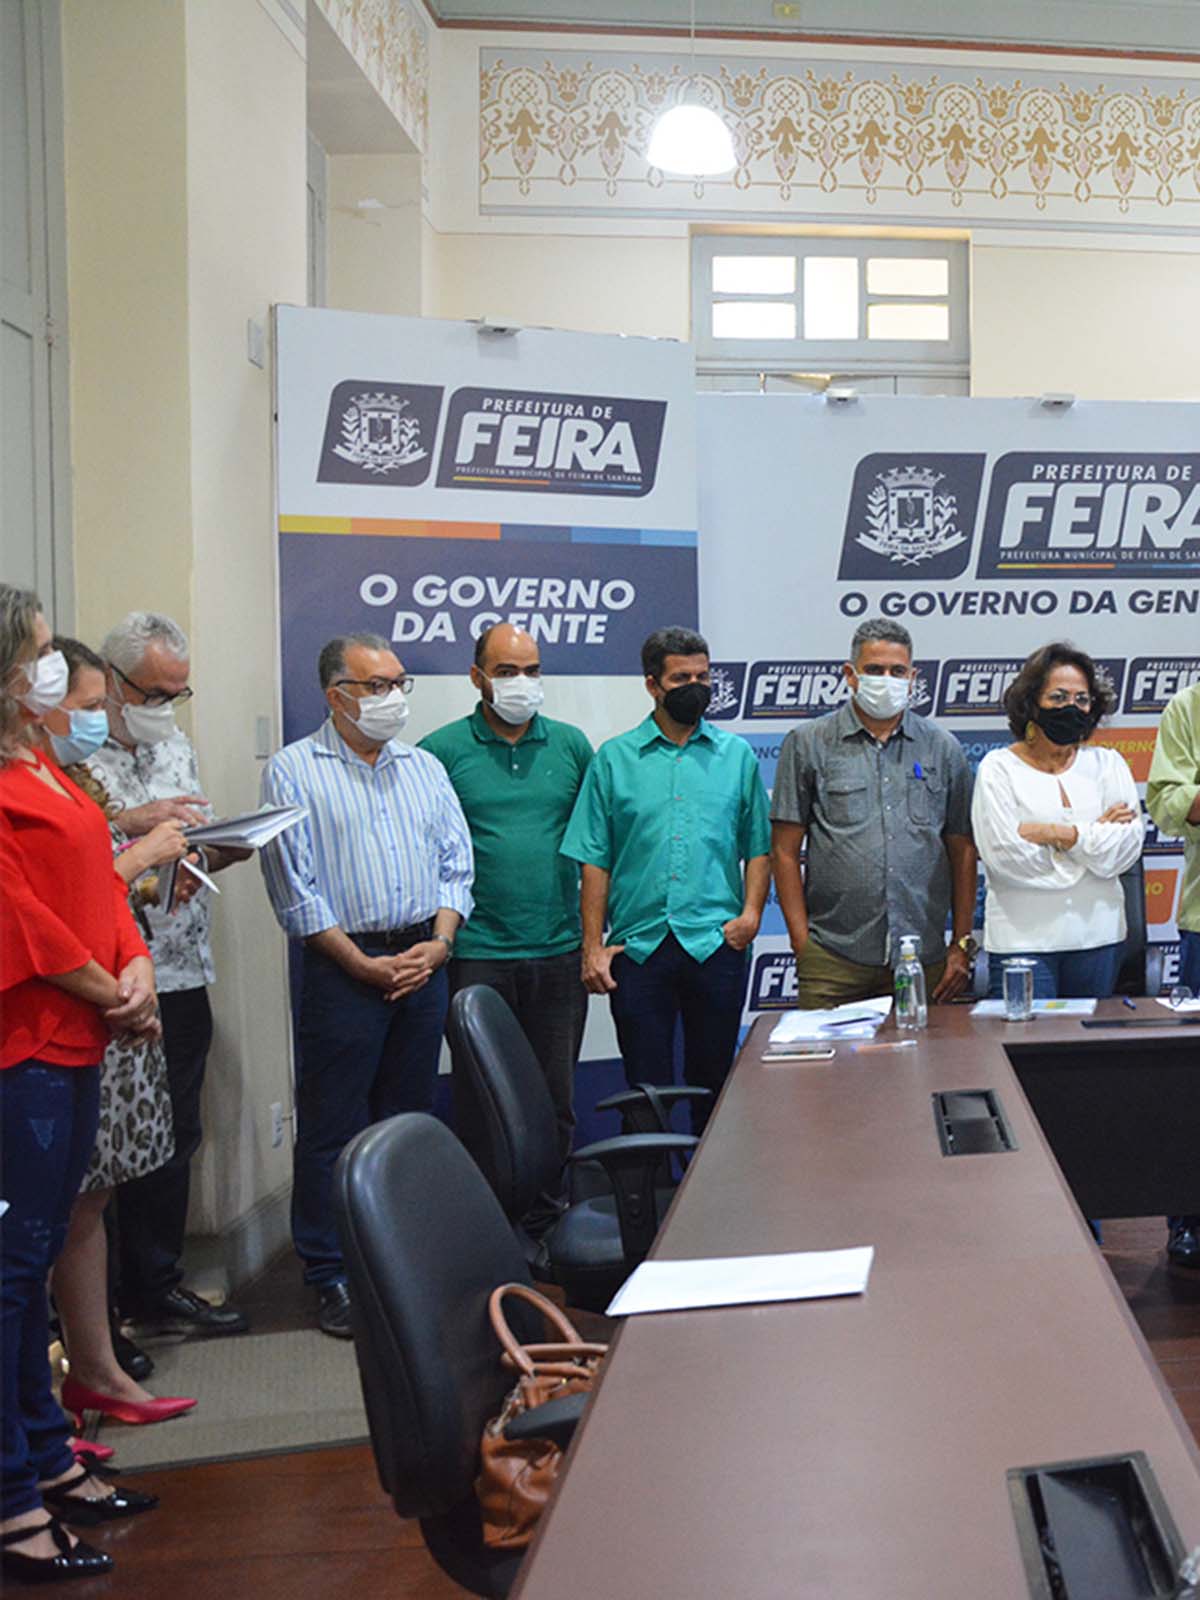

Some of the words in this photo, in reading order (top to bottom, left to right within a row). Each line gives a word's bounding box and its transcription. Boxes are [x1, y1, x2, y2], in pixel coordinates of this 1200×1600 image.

[482, 398, 585, 417] PREFEITURA
[591, 406, 613, 419] DE
[455, 411, 642, 473] FEIRA
[1032, 464, 1156, 480] PREFEITURA
[1166, 465, 1192, 481] DE
[1000, 551, 1060, 560] PREFEITURA
[1064, 551, 1118, 560] MUNICIPAL
[1121, 551, 1134, 560] DE
[1137, 551, 1165, 560] FEIRA
[1169, 551, 1182, 560] DE
[360, 574, 398, 606] O
[412, 575, 635, 610] GOVERNO
[839, 591, 868, 617] O
[879, 590, 1058, 616] GOVERNO
[1069, 589, 1118, 614] DA
[392, 611, 456, 642] DA
[768, 665, 827, 674] PREFEITURA
